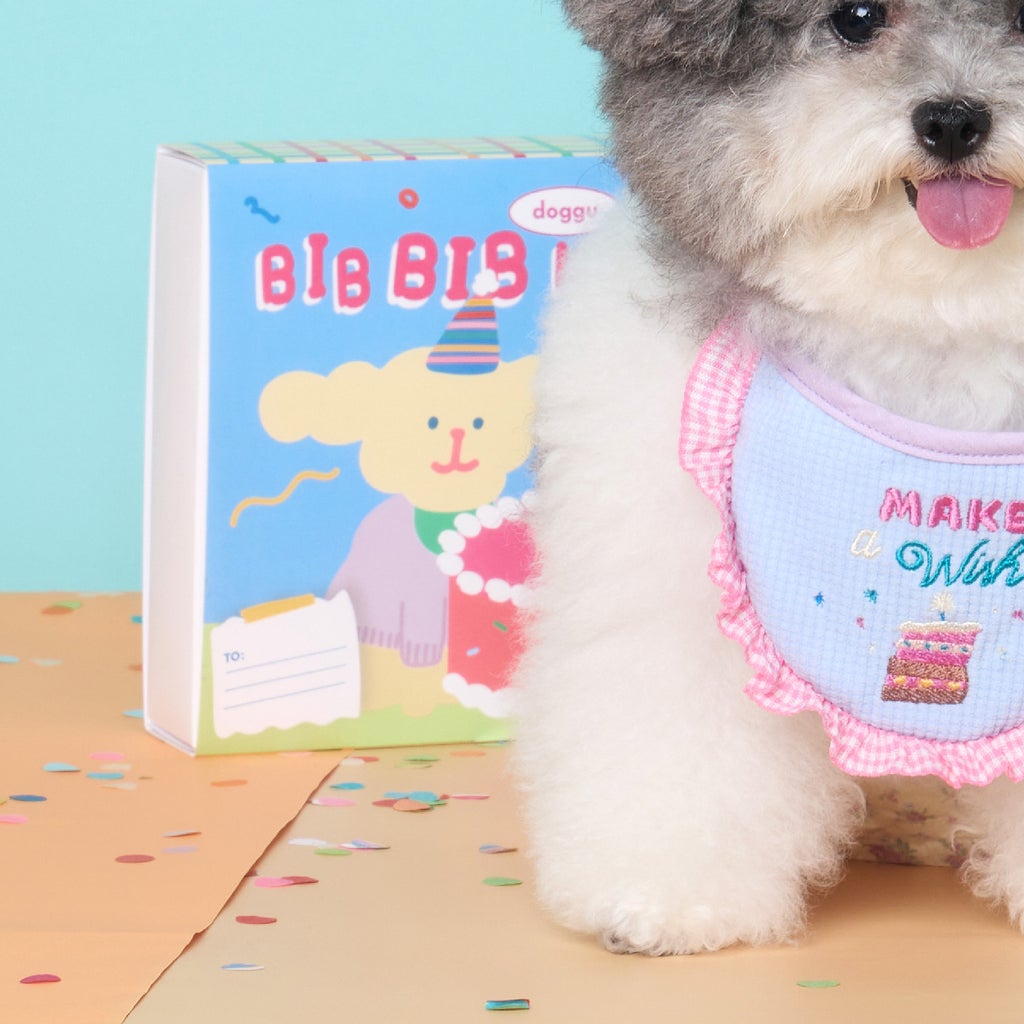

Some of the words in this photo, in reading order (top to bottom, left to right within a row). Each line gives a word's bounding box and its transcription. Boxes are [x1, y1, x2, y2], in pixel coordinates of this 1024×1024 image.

[256, 233, 371, 314] BIB
[388, 230, 529, 308] BIB
[851, 529, 882, 559] a
[223, 651, 246, 663] TO:
